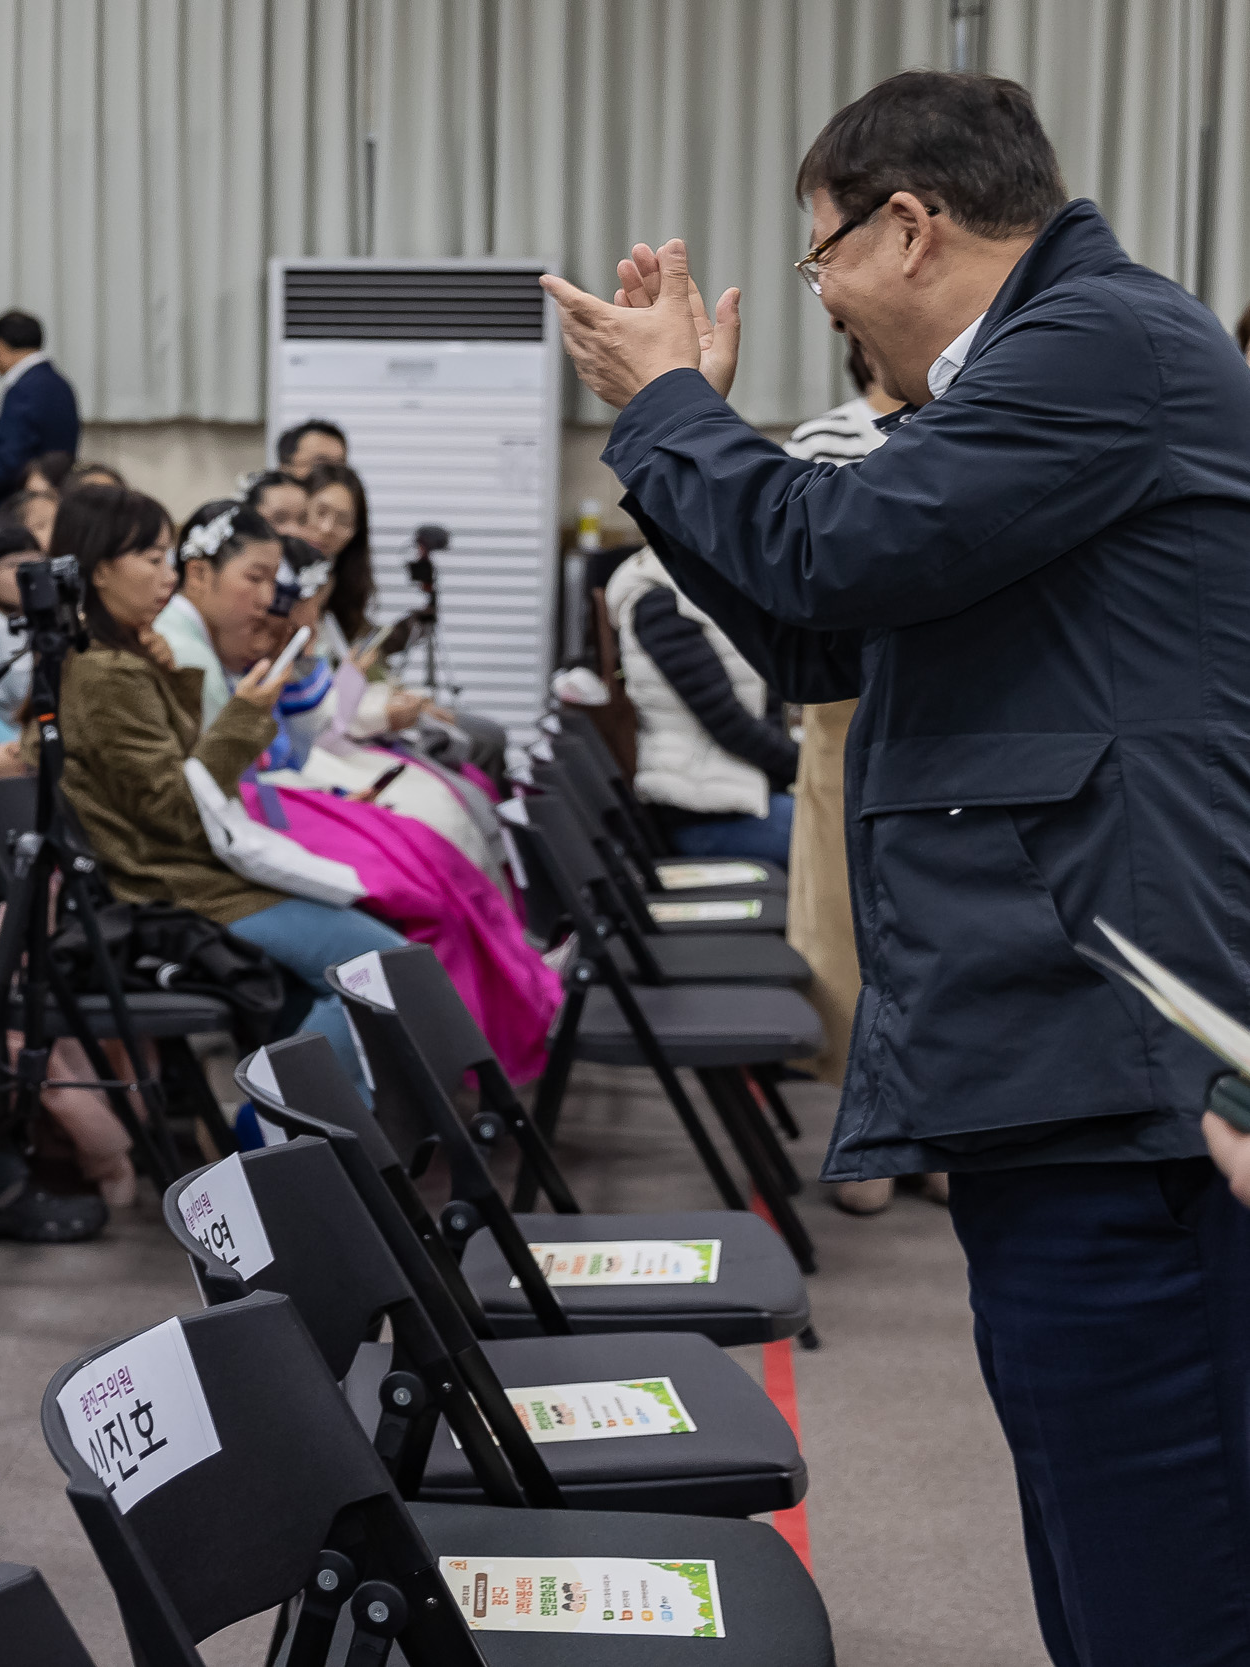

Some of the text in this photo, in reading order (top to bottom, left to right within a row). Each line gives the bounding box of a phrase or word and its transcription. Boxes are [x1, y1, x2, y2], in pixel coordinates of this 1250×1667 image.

[79, 1365, 135, 1422] 광진구의원
[88, 1398, 168, 1496] 신진호
[491, 1586, 509, 1606] 광진구
[515, 1576, 533, 1615] 지역아동센터
